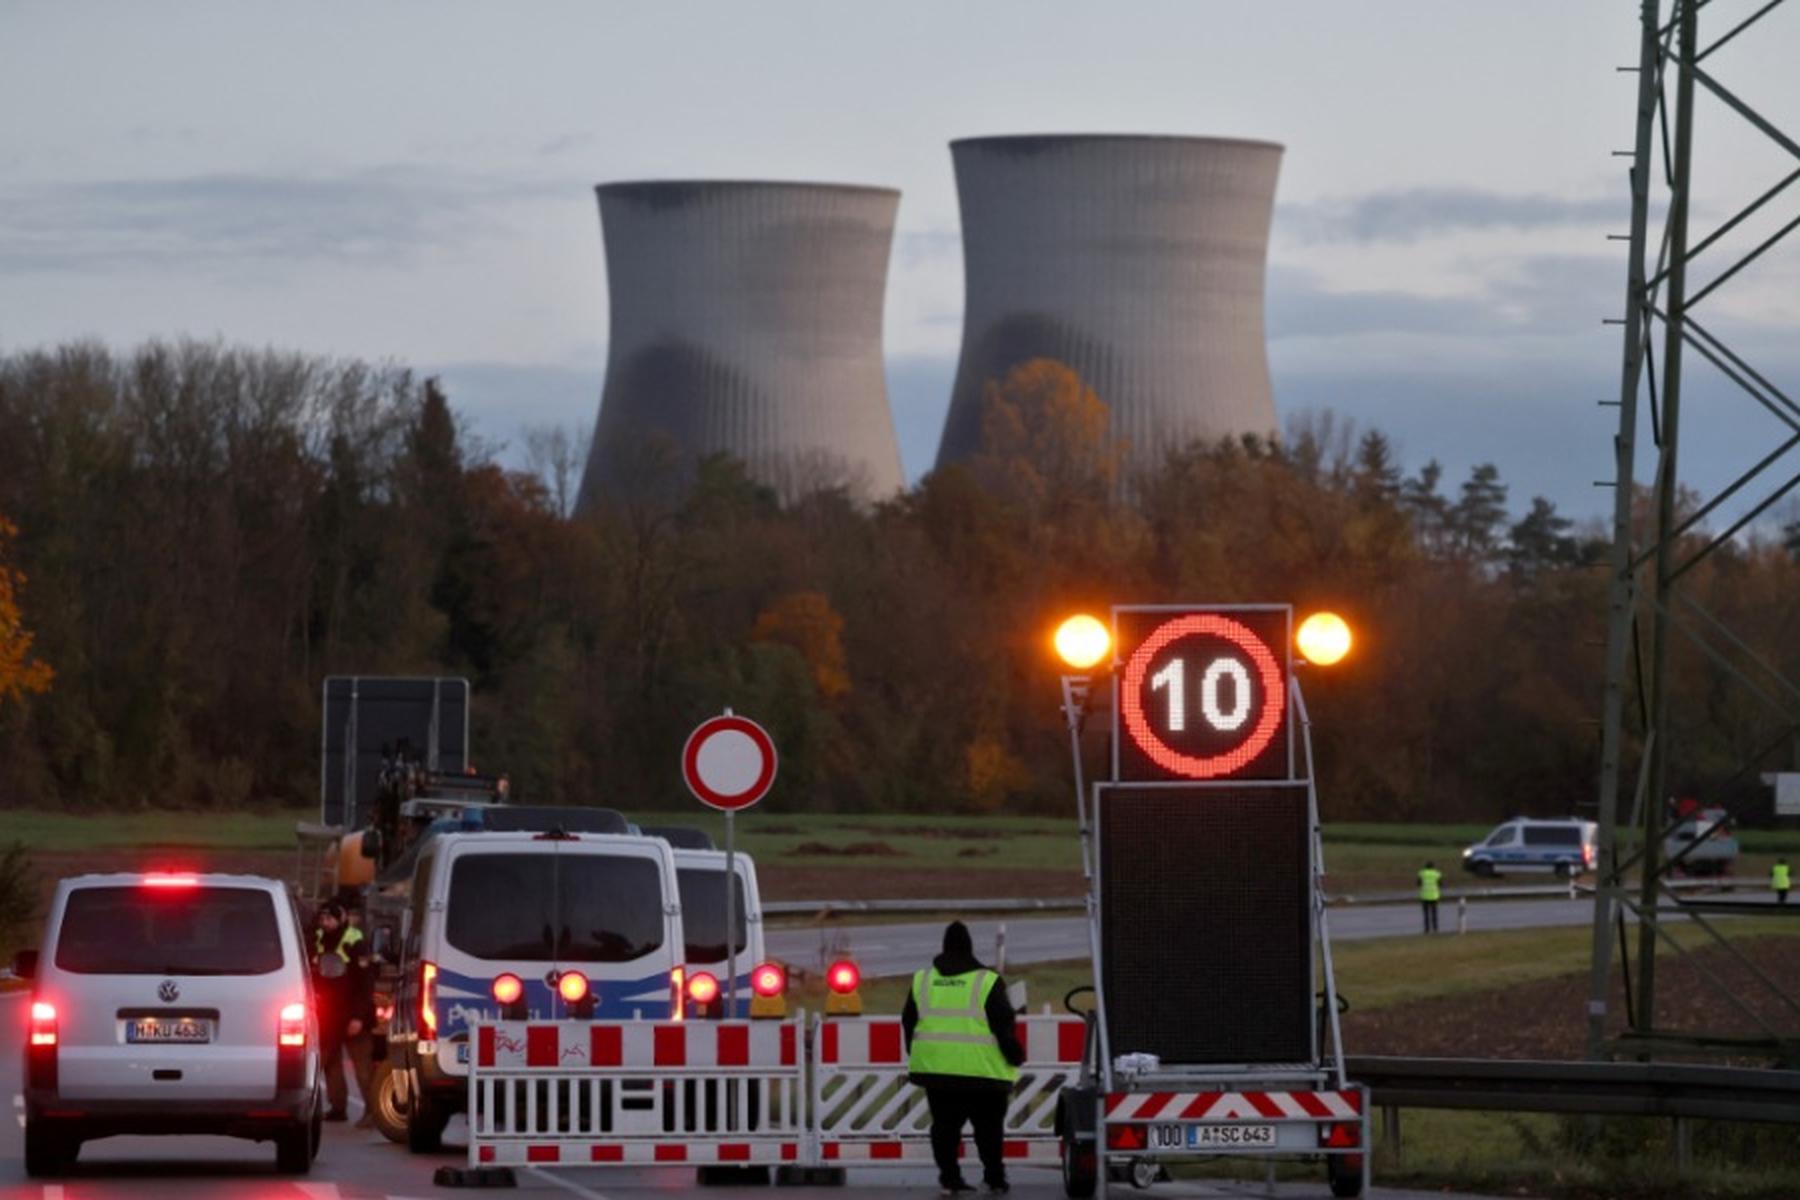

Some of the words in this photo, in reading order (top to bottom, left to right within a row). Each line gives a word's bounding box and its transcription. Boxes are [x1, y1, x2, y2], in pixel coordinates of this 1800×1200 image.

[1152, 658, 1250, 731] 10
[1157, 1124, 1182, 1147] 100
[1201, 1127, 1211, 1142] A
[1243, 1126, 1271, 1142] 643
